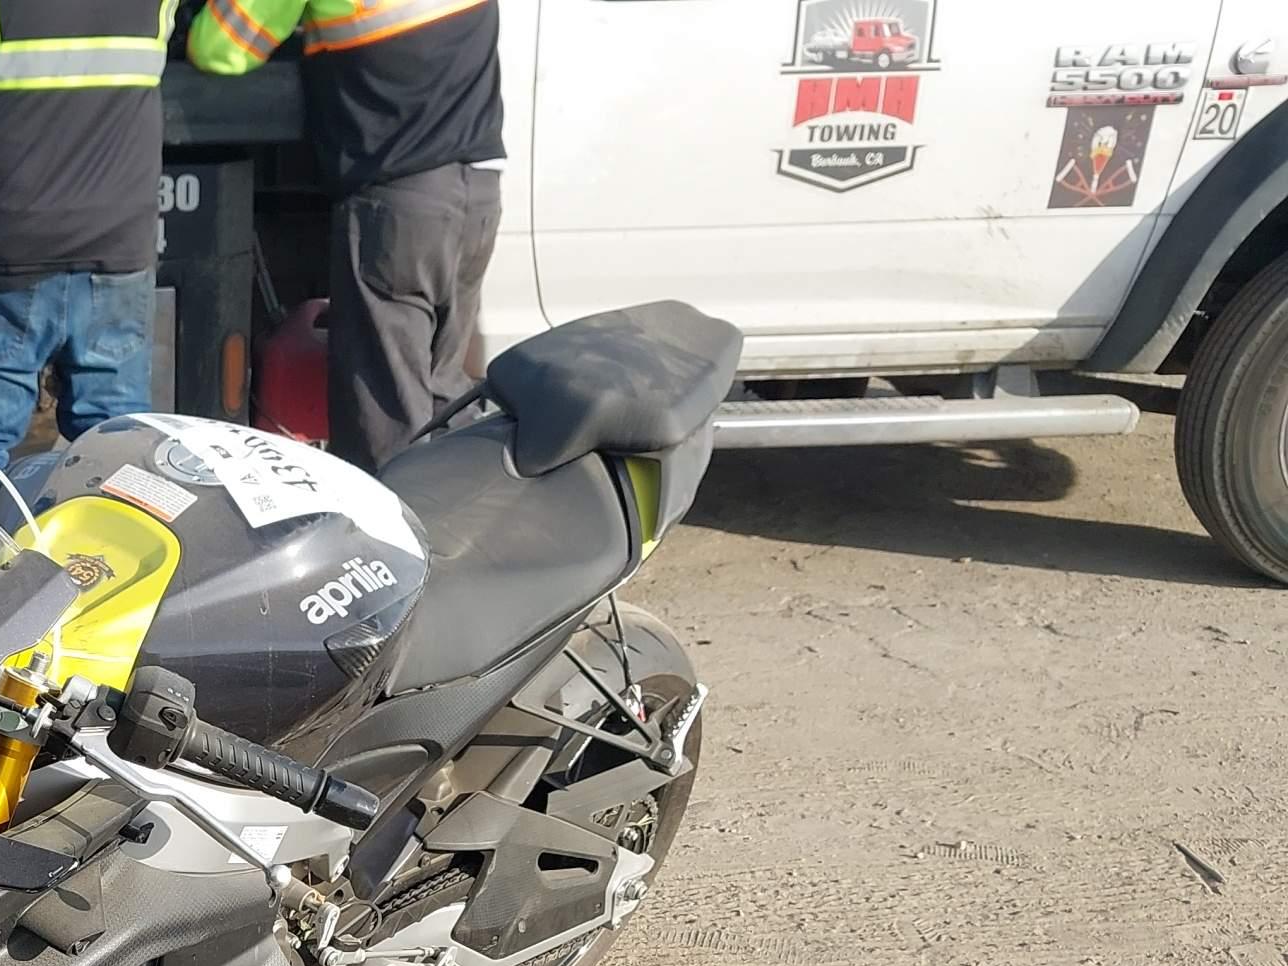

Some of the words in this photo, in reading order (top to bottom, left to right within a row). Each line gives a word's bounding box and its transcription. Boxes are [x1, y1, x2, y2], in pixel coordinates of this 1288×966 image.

[1054, 42, 1195, 67] RAM
[1050, 67, 1191, 91] 5500
[1199, 103, 1237, 135] 20
[807, 122, 898, 143] TOWING
[298, 556, 397, 626] aprilia
